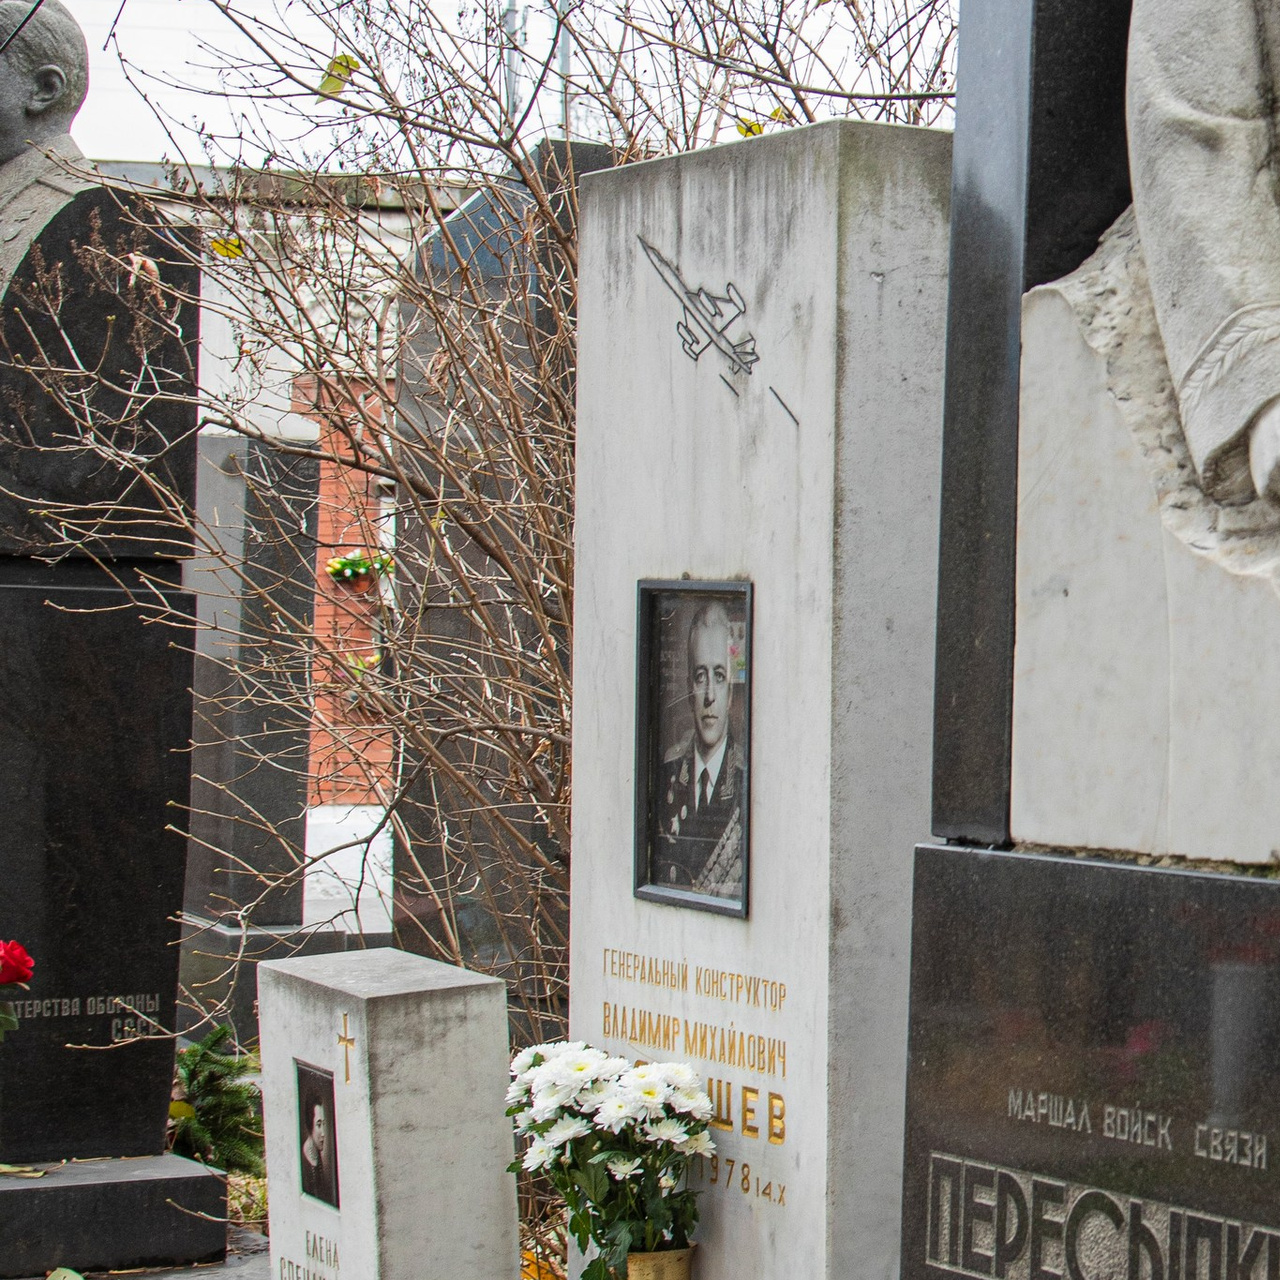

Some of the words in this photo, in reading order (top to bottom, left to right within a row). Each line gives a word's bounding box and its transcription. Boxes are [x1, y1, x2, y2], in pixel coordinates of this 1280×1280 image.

[603, 948, 688, 992] ГЕНЕРАЛЬНЫЙ
[695, 966, 786, 1011] КОНСТРУКТОР
[603, 1001, 681, 1052] ВЛАДИМИР
[684, 1020, 786, 1078] МИХАЙЛОВИЧ
[1008, 1089, 1092, 1134] МАРШАЛ
[1103, 1101, 1172, 1150] ВОЙСК
[1194, 1123, 1267, 1169] СВЯЗИ
[306, 1230, 341, 1271] ЕЛЕНА
